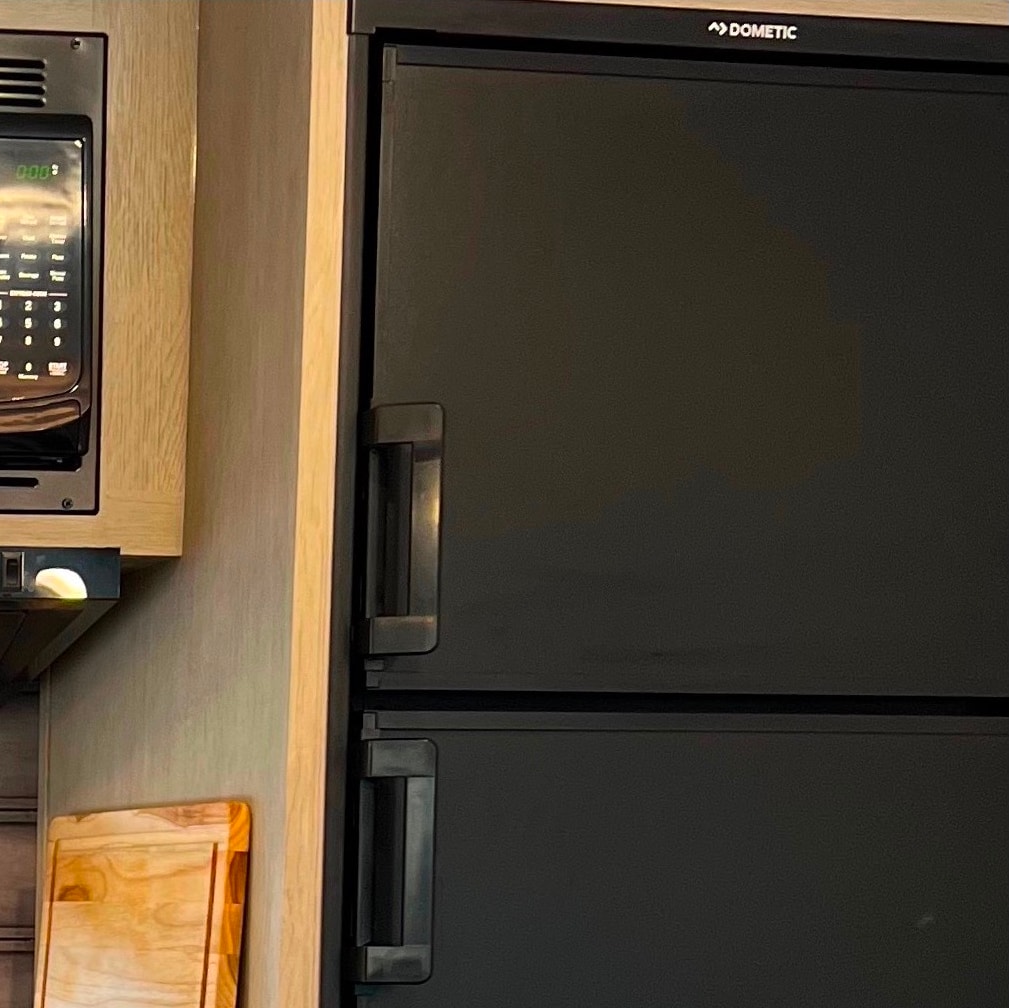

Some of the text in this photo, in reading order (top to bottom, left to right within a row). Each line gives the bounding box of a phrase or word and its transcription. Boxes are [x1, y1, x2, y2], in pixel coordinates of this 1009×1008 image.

[729, 22, 798, 39] DOMETIC
[24, 300, 33, 312] 2
[53, 301, 62, 312] 3
[24, 317, 33, 329] 5
[53, 318, 62, 330] 6
[53, 336, 61, 347] 9
